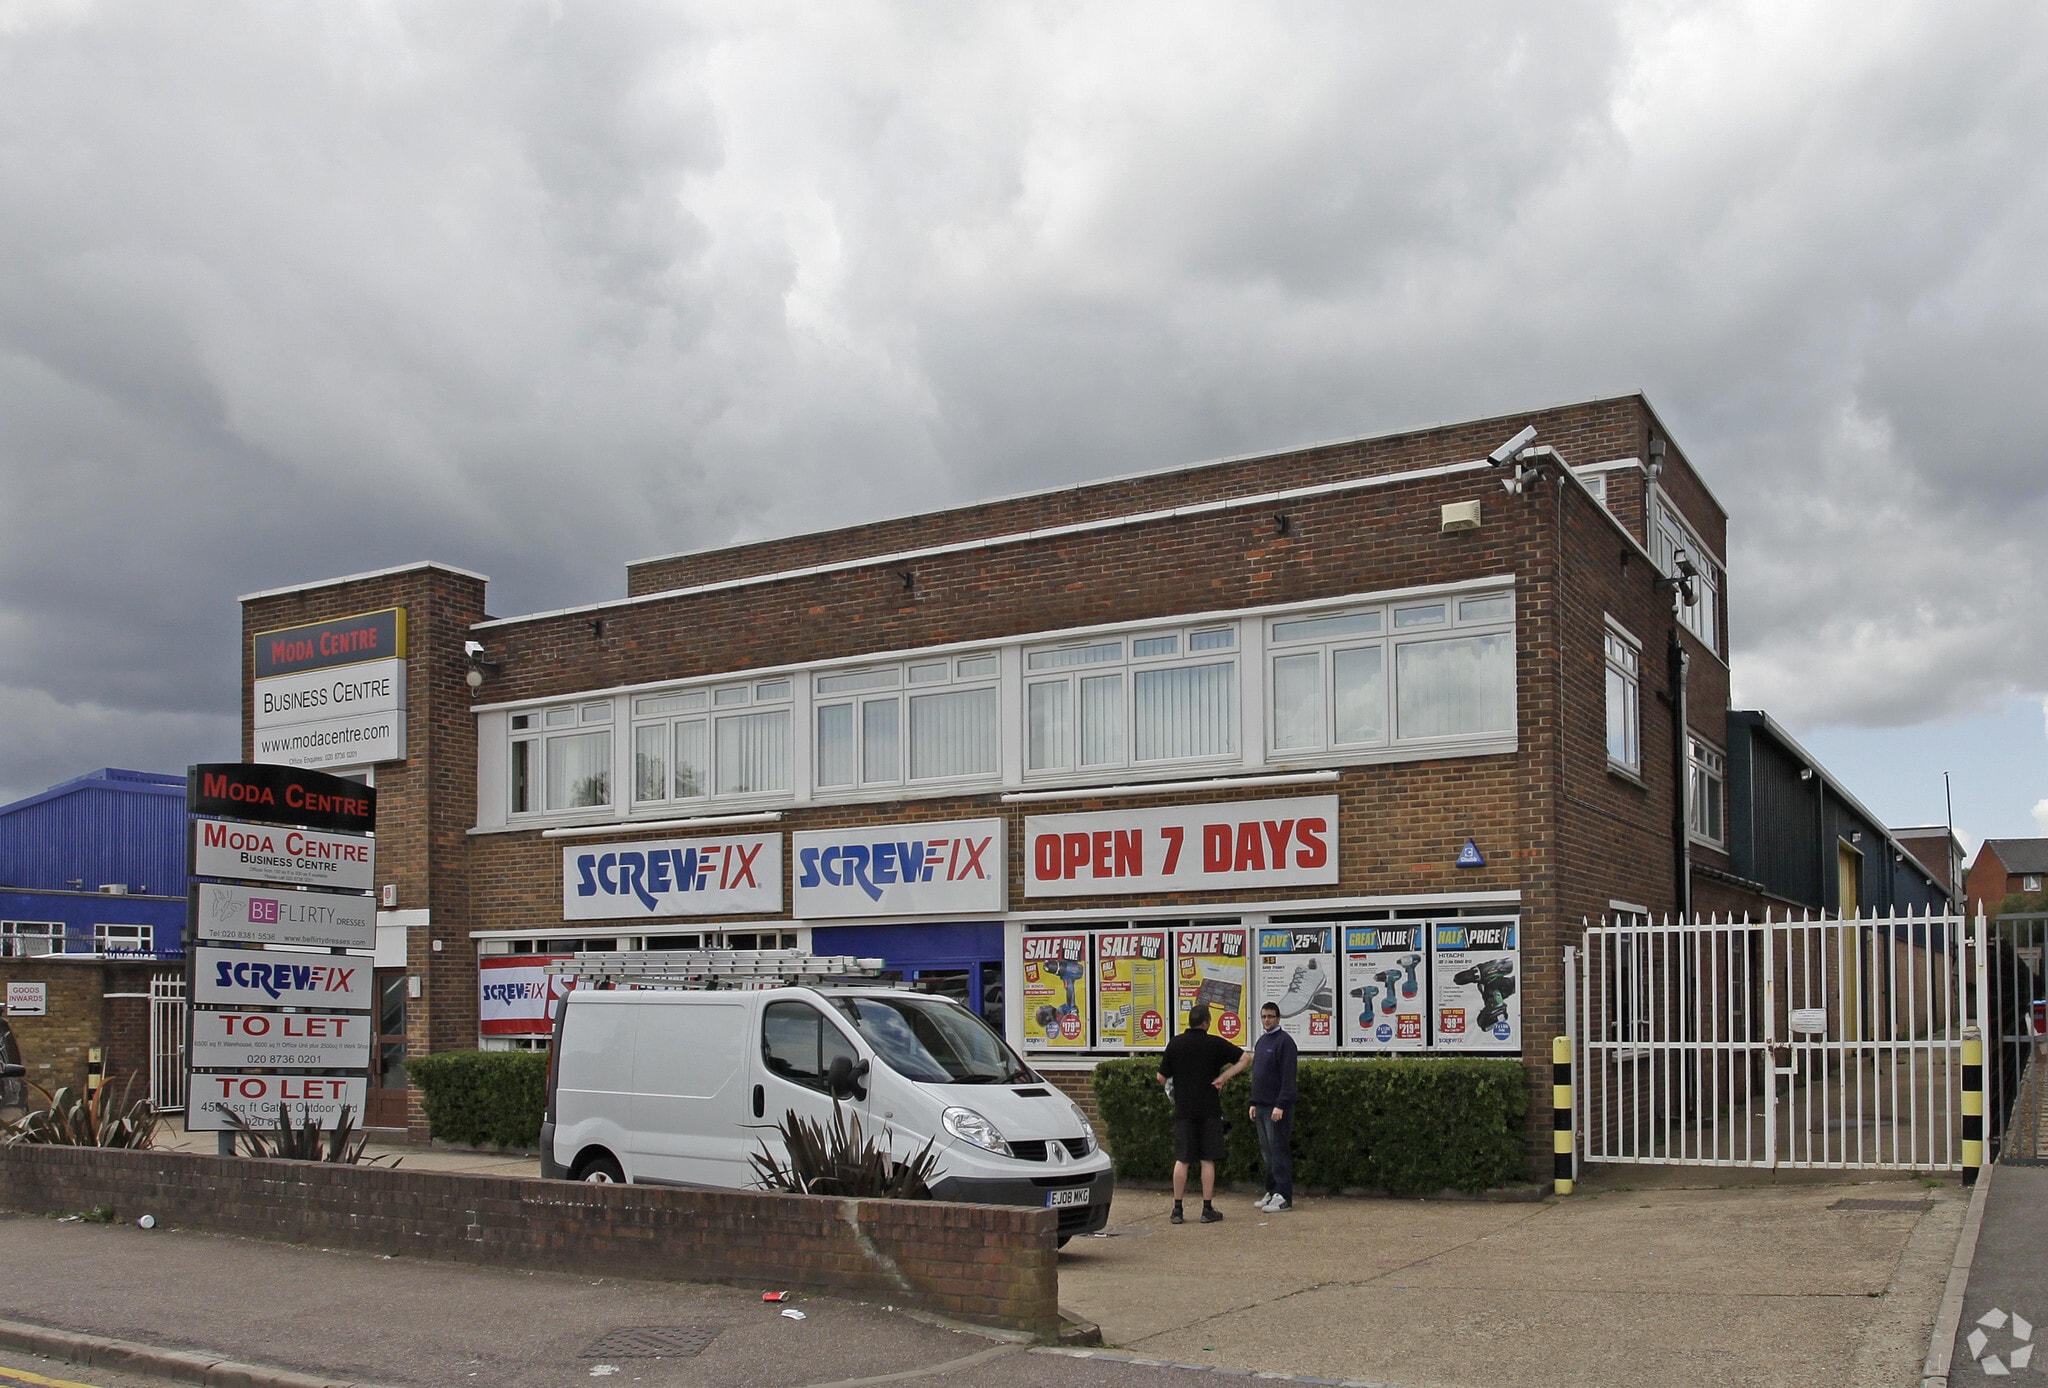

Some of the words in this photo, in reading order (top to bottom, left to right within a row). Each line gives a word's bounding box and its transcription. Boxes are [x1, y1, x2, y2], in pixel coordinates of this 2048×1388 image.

[272, 638, 314, 665] MODA
[319, 627, 378, 656] CENTRE
[264, 688, 328, 713] BUSINESS
[332, 678, 390, 703] CENTRE
[261, 724, 390, 753] www.modacentre.com
[203, 772, 275, 805] MODA
[285, 783, 369, 817] CENTRE
[204, 823, 275, 853] MODA
[285, 832, 368, 862] CENTRE
[1035, 829, 1143, 881] OPEN
[1160, 826, 1184, 875] 7
[1203, 817, 1327, 873] DAYS
[241, 852, 293, 868] BUSINESS
[296, 858, 338, 872] CENTRE
[799, 836, 993, 902] SCREWFIX
[577, 842, 763, 912] SCREWFIX
[336, 917, 366, 928] DRESSES
[1101, 936, 1139, 957] SALE
[1141, 935, 1161, 948] NOW
[1180, 932, 1219, 953] SALE
[1221, 932, 1242, 945] NOW
[1262, 934, 1288, 948] SAVE
[1295, 934, 1317, 948] 25%
[1349, 931, 1376, 946] GREAT
[1381, 930, 1407, 946] VALUE
[1438, 929, 1463, 944] HALF
[1469, 928, 1501, 944] PRICE
[1024, 939, 1061, 959] SALE
[1062, 938, 1081, 950] NOW
[1064, 949, 1078, 960] ON!
[1142, 946, 1157, 959] ON!
[1223, 943, 1239, 956] ON!
[215, 961, 355, 1000] SCREWFIX
[483, 982, 546, 1006] SCREWFIX
[219, 1015, 270, 1036] TO
[284, 1017, 350, 1037] LET
[247, 1055, 266, 1064] 020
[269, 1055, 295, 1064] 8736
[297, 1055, 321, 1064] 0201
[215, 1078, 267, 1098] TO
[280, 1080, 346, 1099] LET
[232, 1103, 245, 1113] sq
[250, 1102, 257, 1112] ft
[261, 1102, 292, 1113] Gatd
[295, 1102, 335, 1113] Otdoor
[339, 1103, 358, 1113] Yrd
[267, 1117, 293, 1127] 876
[1052, 1192, 1073, 1205] EJ08
[1074, 1190, 1088, 1202] MKG
